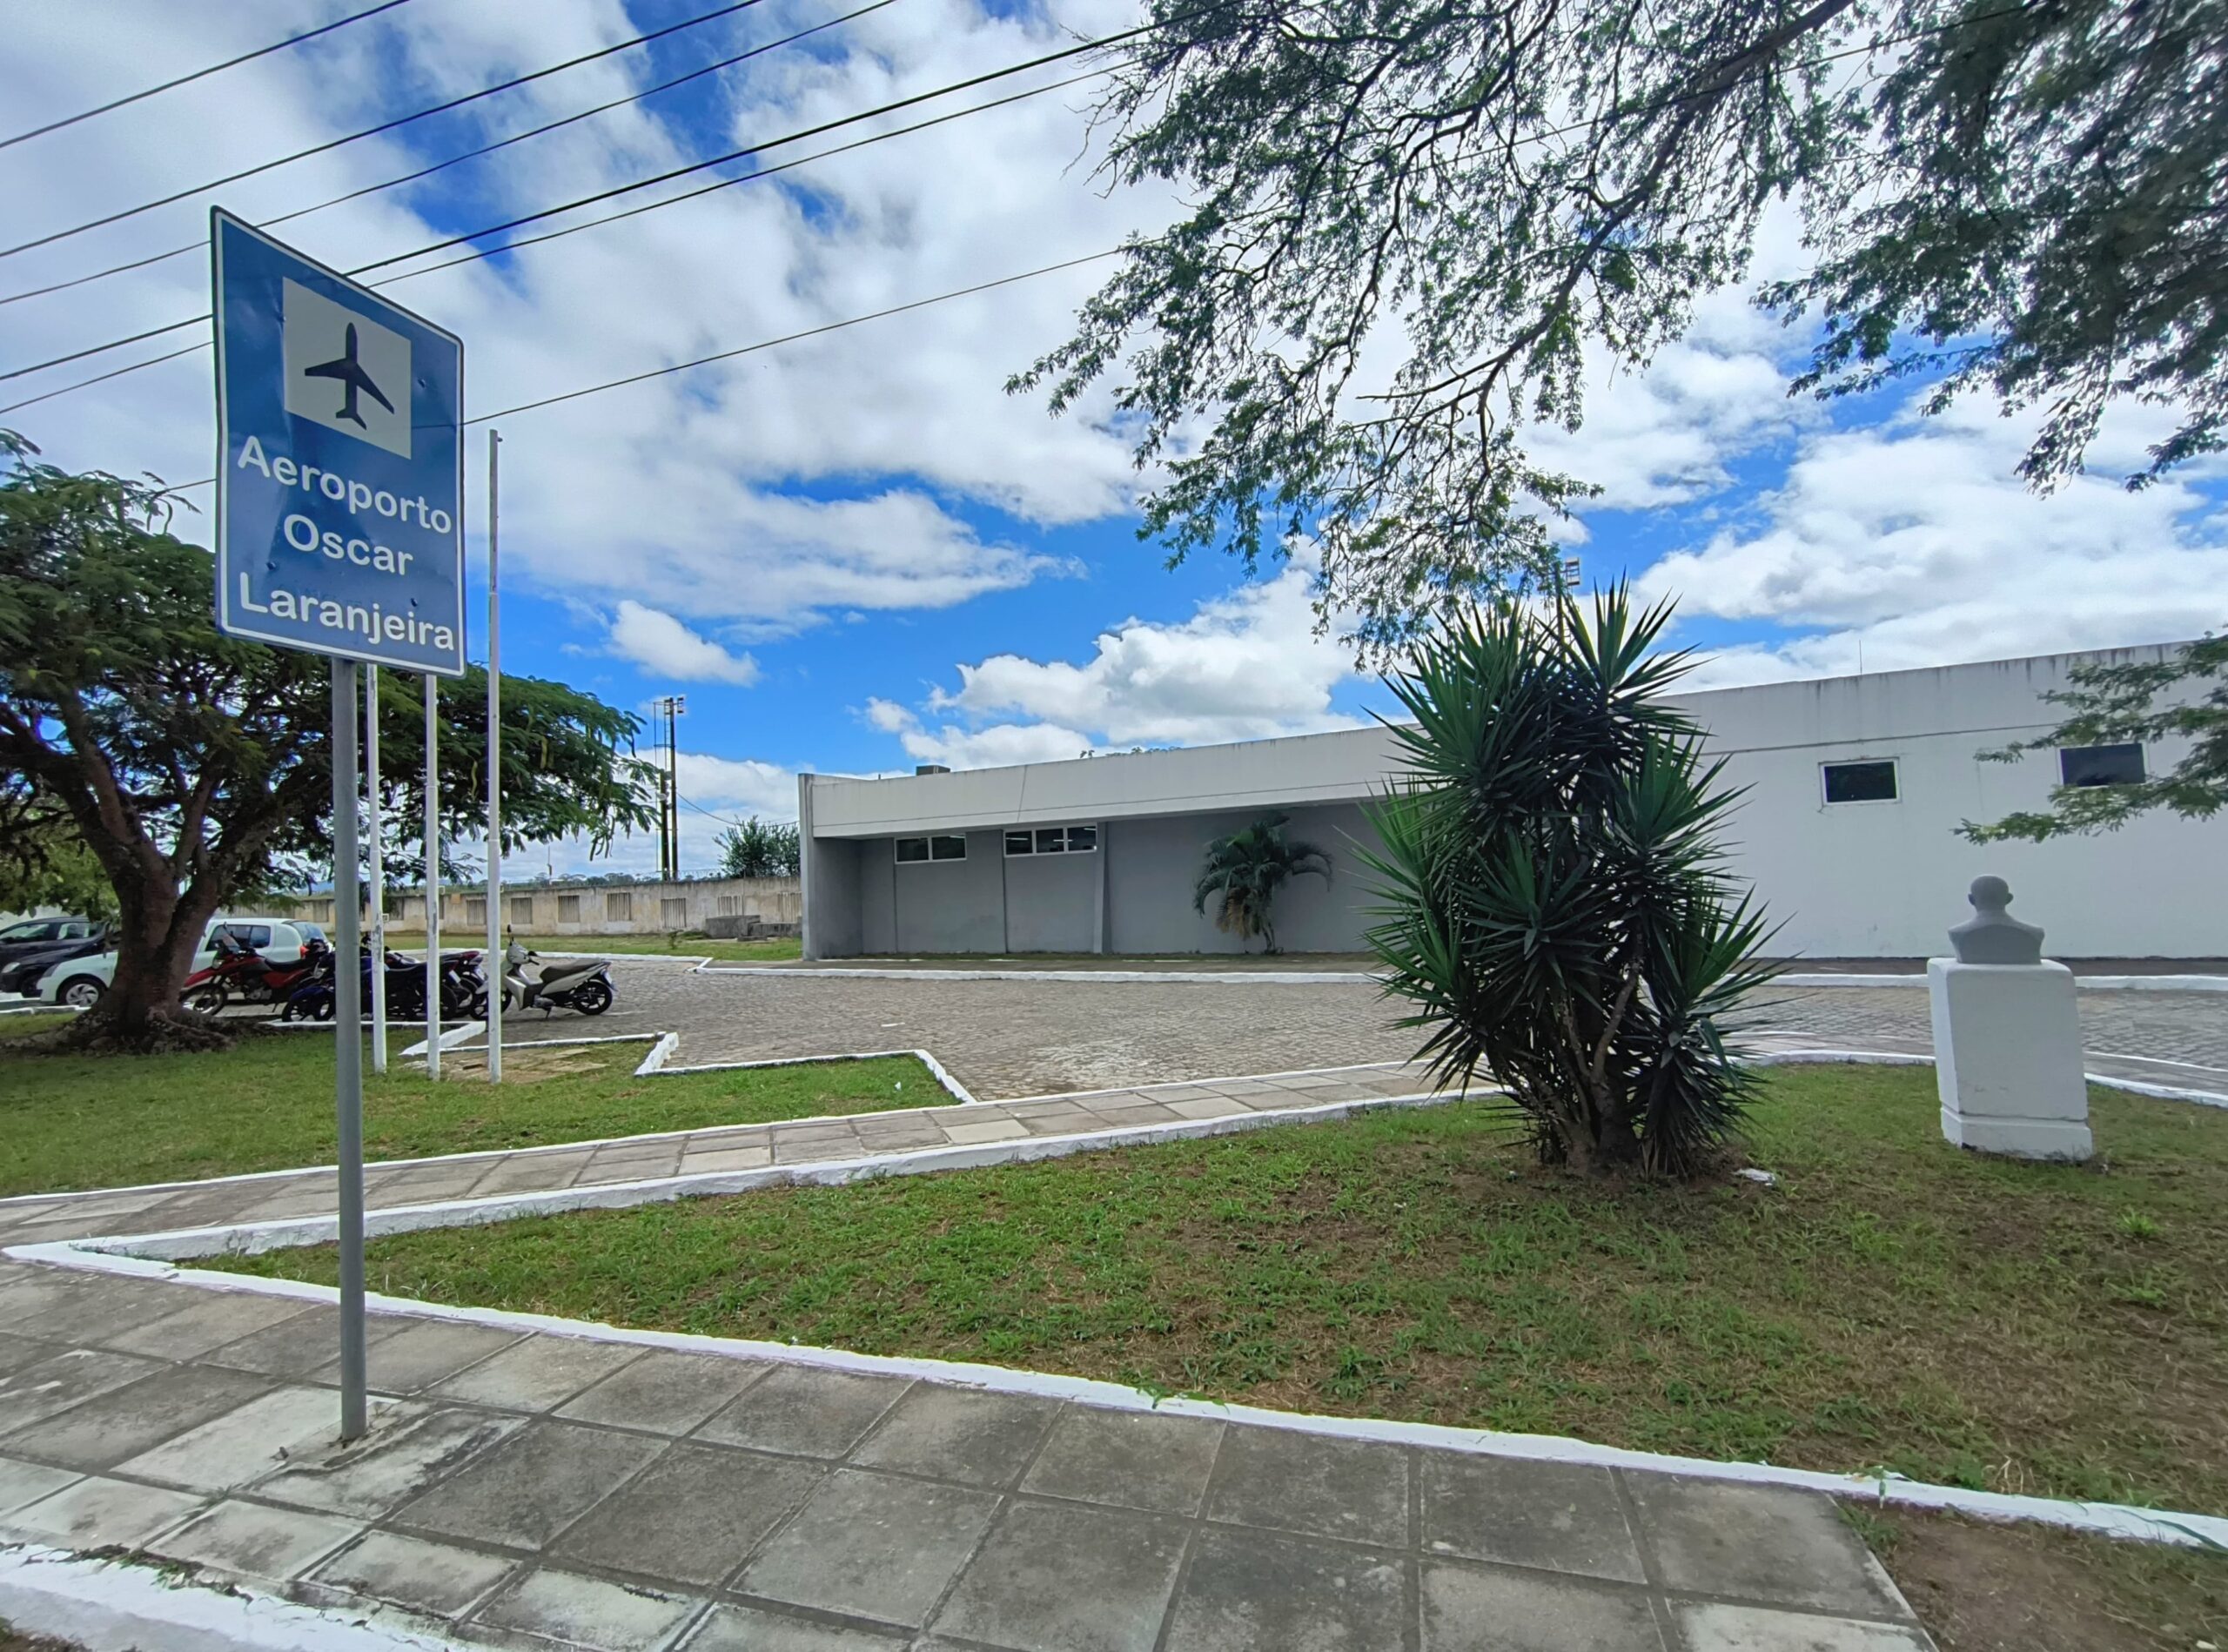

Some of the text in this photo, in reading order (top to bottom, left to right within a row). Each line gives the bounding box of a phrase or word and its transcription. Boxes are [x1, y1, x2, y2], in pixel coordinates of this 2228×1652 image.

[238, 436, 452, 534] Aeroporto
[283, 514, 413, 575] Oscar
[239, 571, 454, 651] Laranjeira
